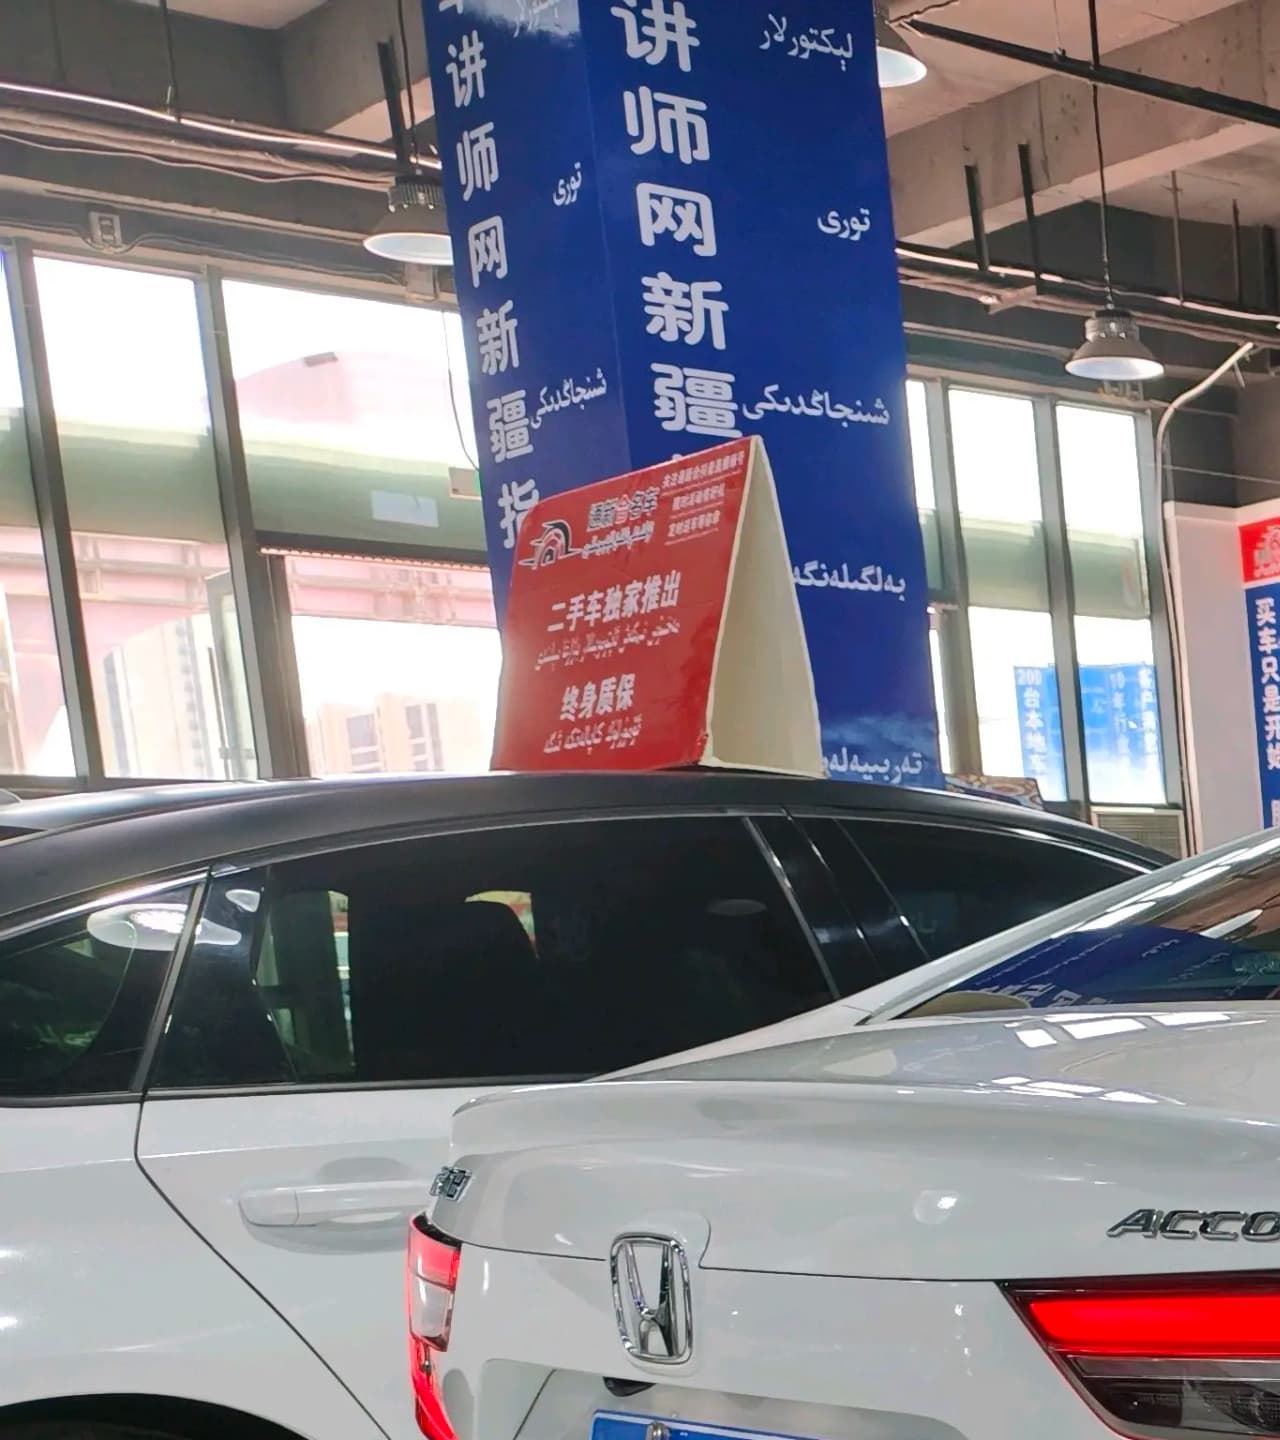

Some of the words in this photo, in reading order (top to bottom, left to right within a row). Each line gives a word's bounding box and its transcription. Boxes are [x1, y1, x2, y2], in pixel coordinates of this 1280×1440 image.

[438, 0, 540, 549] 讲师网新疆指
[611, 0, 743, 462] 讲师网新疆
[546, 569, 682, 632] 二手车独家推出
[560, 672, 636, 723] 终身质保
